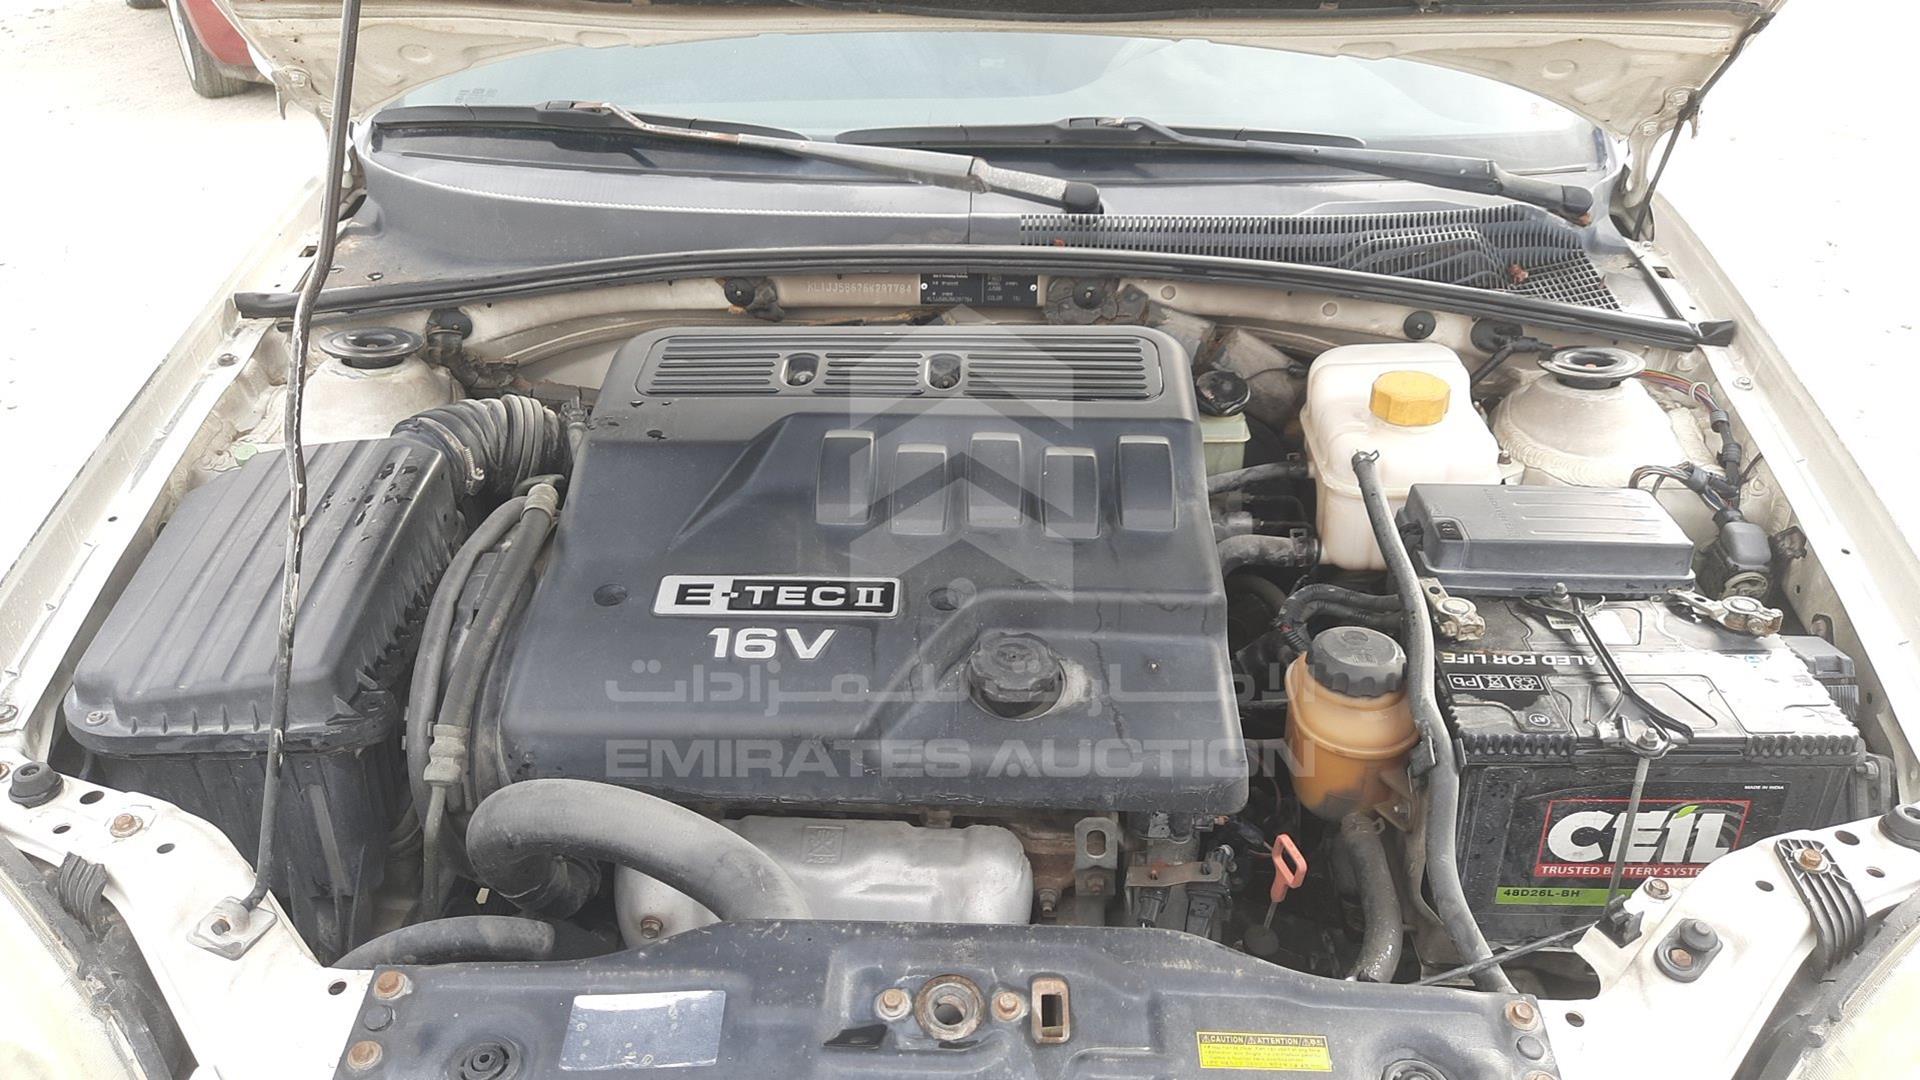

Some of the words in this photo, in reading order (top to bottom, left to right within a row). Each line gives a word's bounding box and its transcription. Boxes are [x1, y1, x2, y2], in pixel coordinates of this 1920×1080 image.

[706, 627, 836, 659] 16V
[1443, 652, 1488, 664] LIFE
[1492, 654, 1536, 665] FOR
[1541, 655, 1599, 666] ALED
[1452, 676, 1478, 688] Pb
[1542, 865, 1600, 876] TRUSTED
[1603, 866, 1660, 876] BTTERY
[1663, 867, 1702, 877] SYSTE
[1210, 1035, 1244, 1044] CAUTION
[1257, 1036, 1298, 1046] ATTENTION
